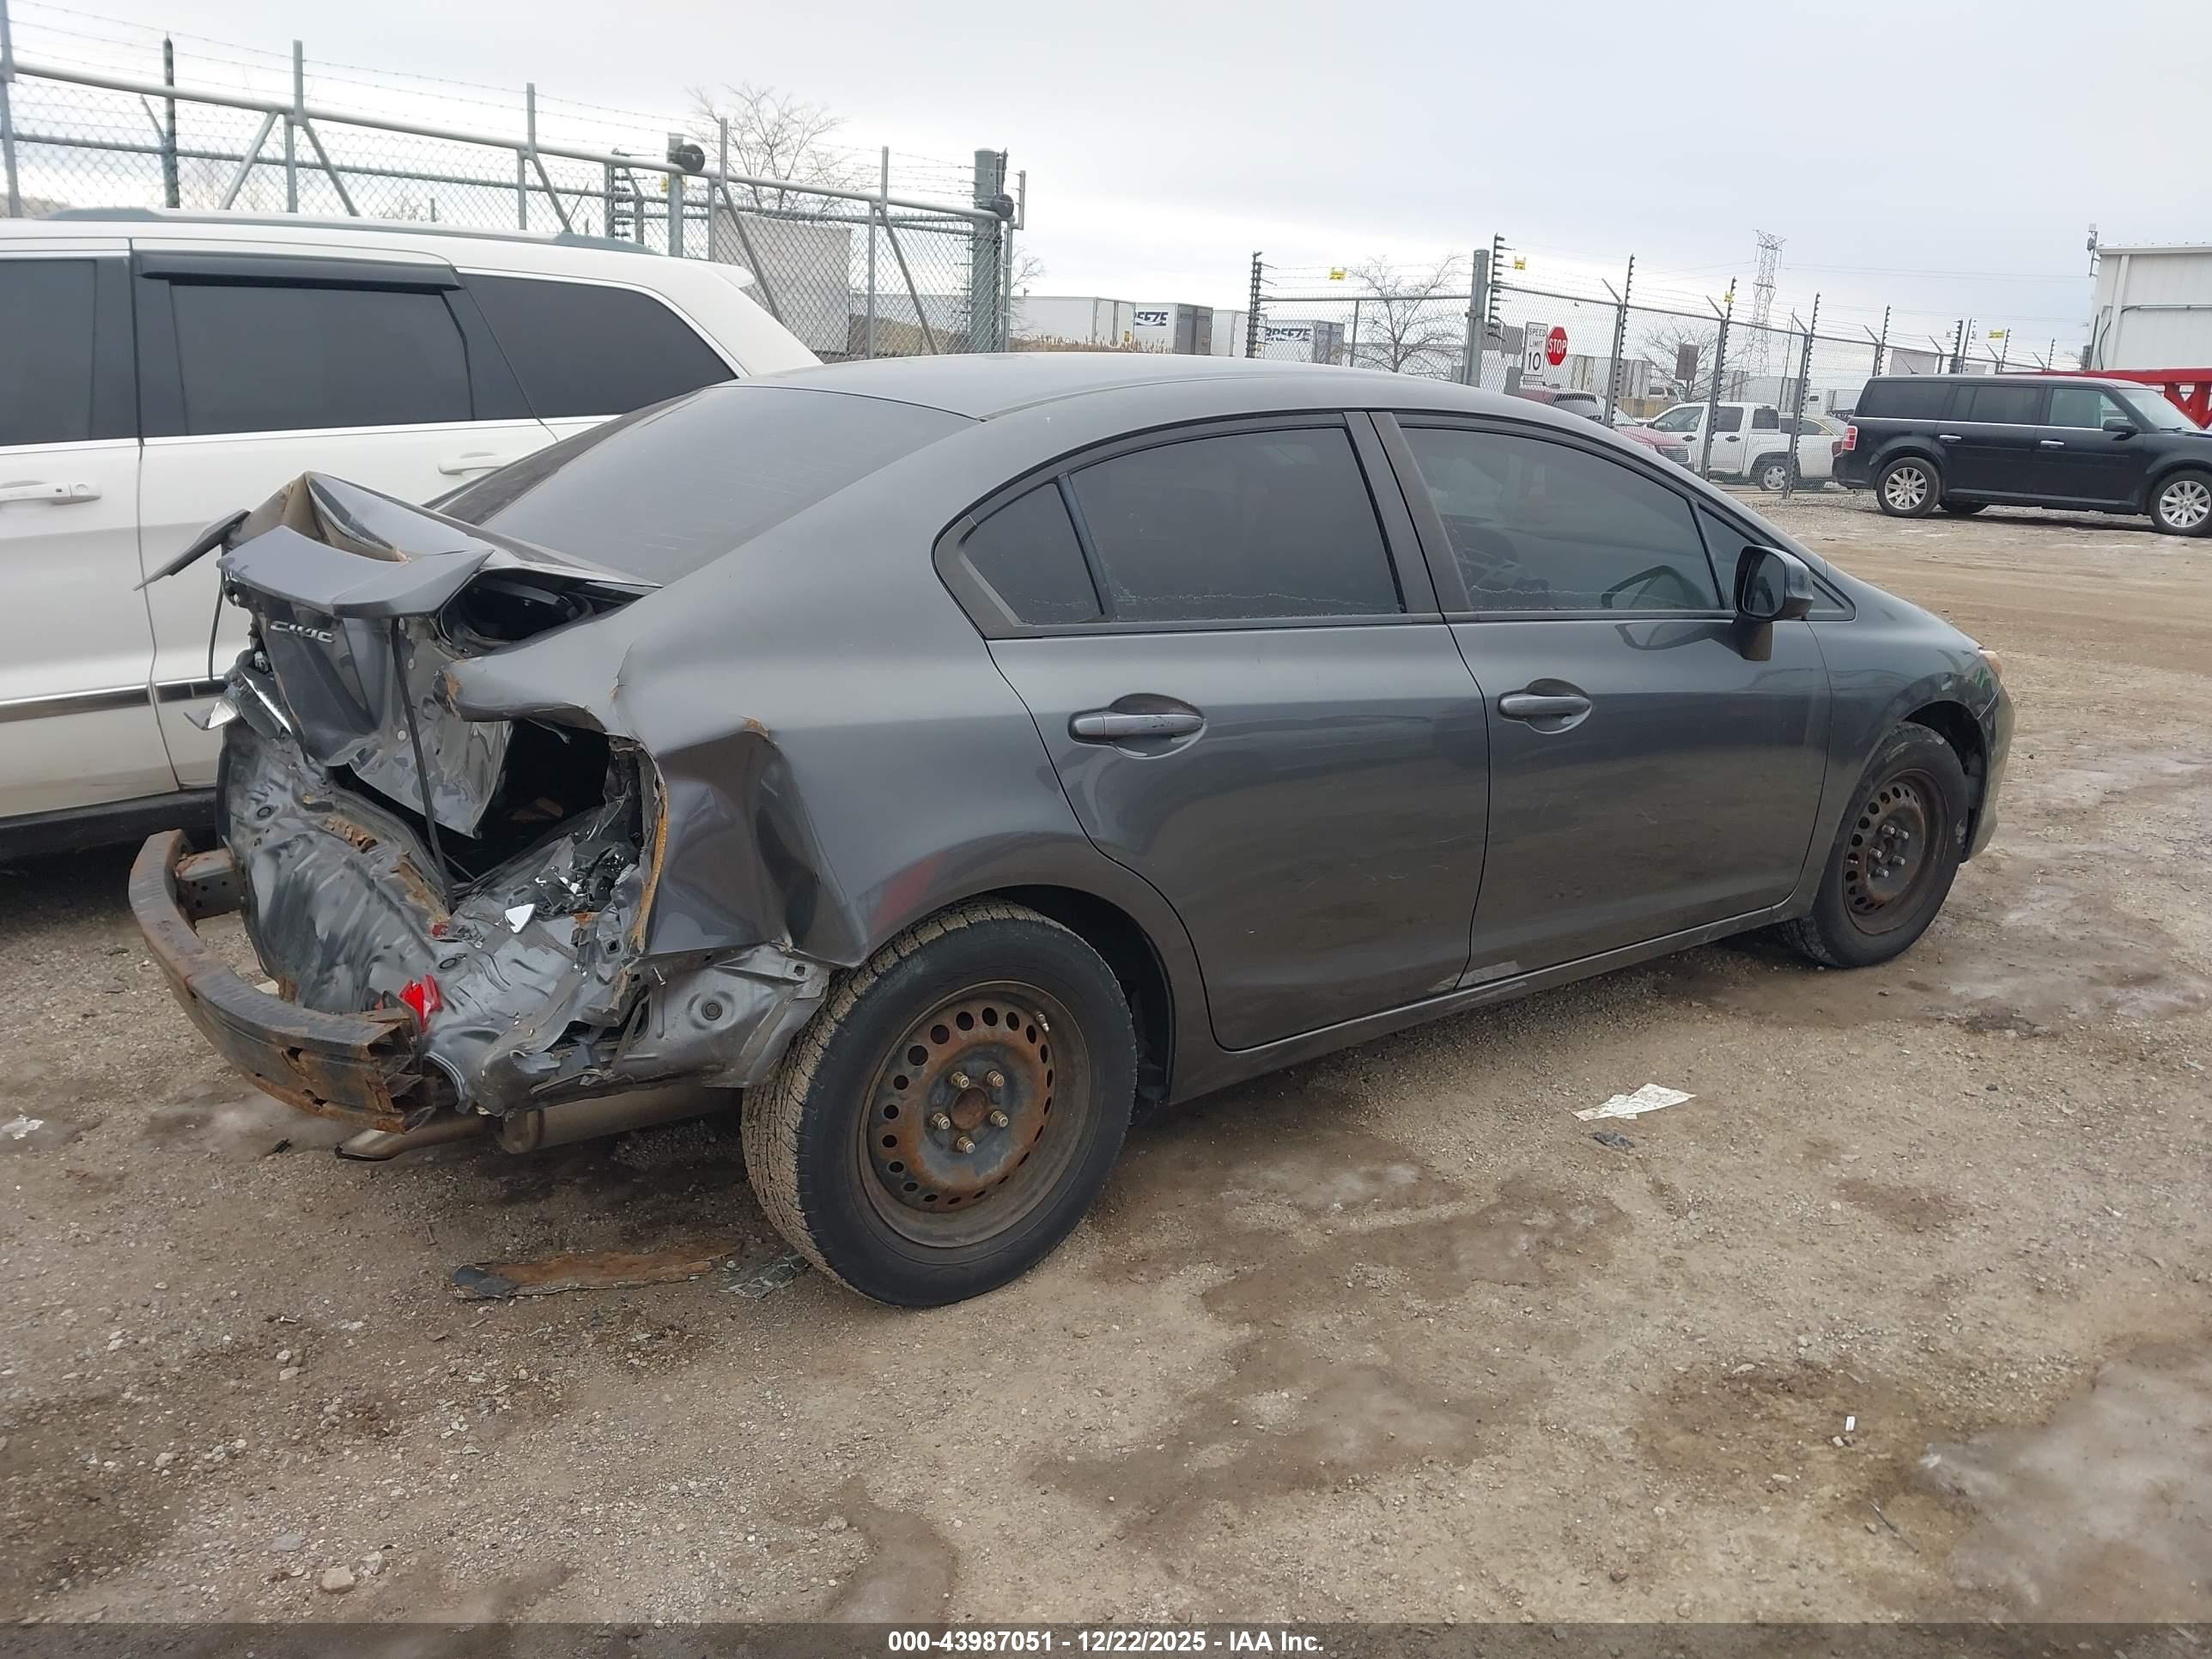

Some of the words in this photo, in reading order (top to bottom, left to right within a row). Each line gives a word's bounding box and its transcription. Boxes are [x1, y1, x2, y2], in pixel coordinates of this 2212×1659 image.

[1528, 328, 1546, 337] SPEED
[1529, 338, 1544, 349] LIMIT
[1548, 337, 1567, 355] STOP
[1528, 351, 1541, 371] 10
[270, 620, 334, 644] CIVIC
